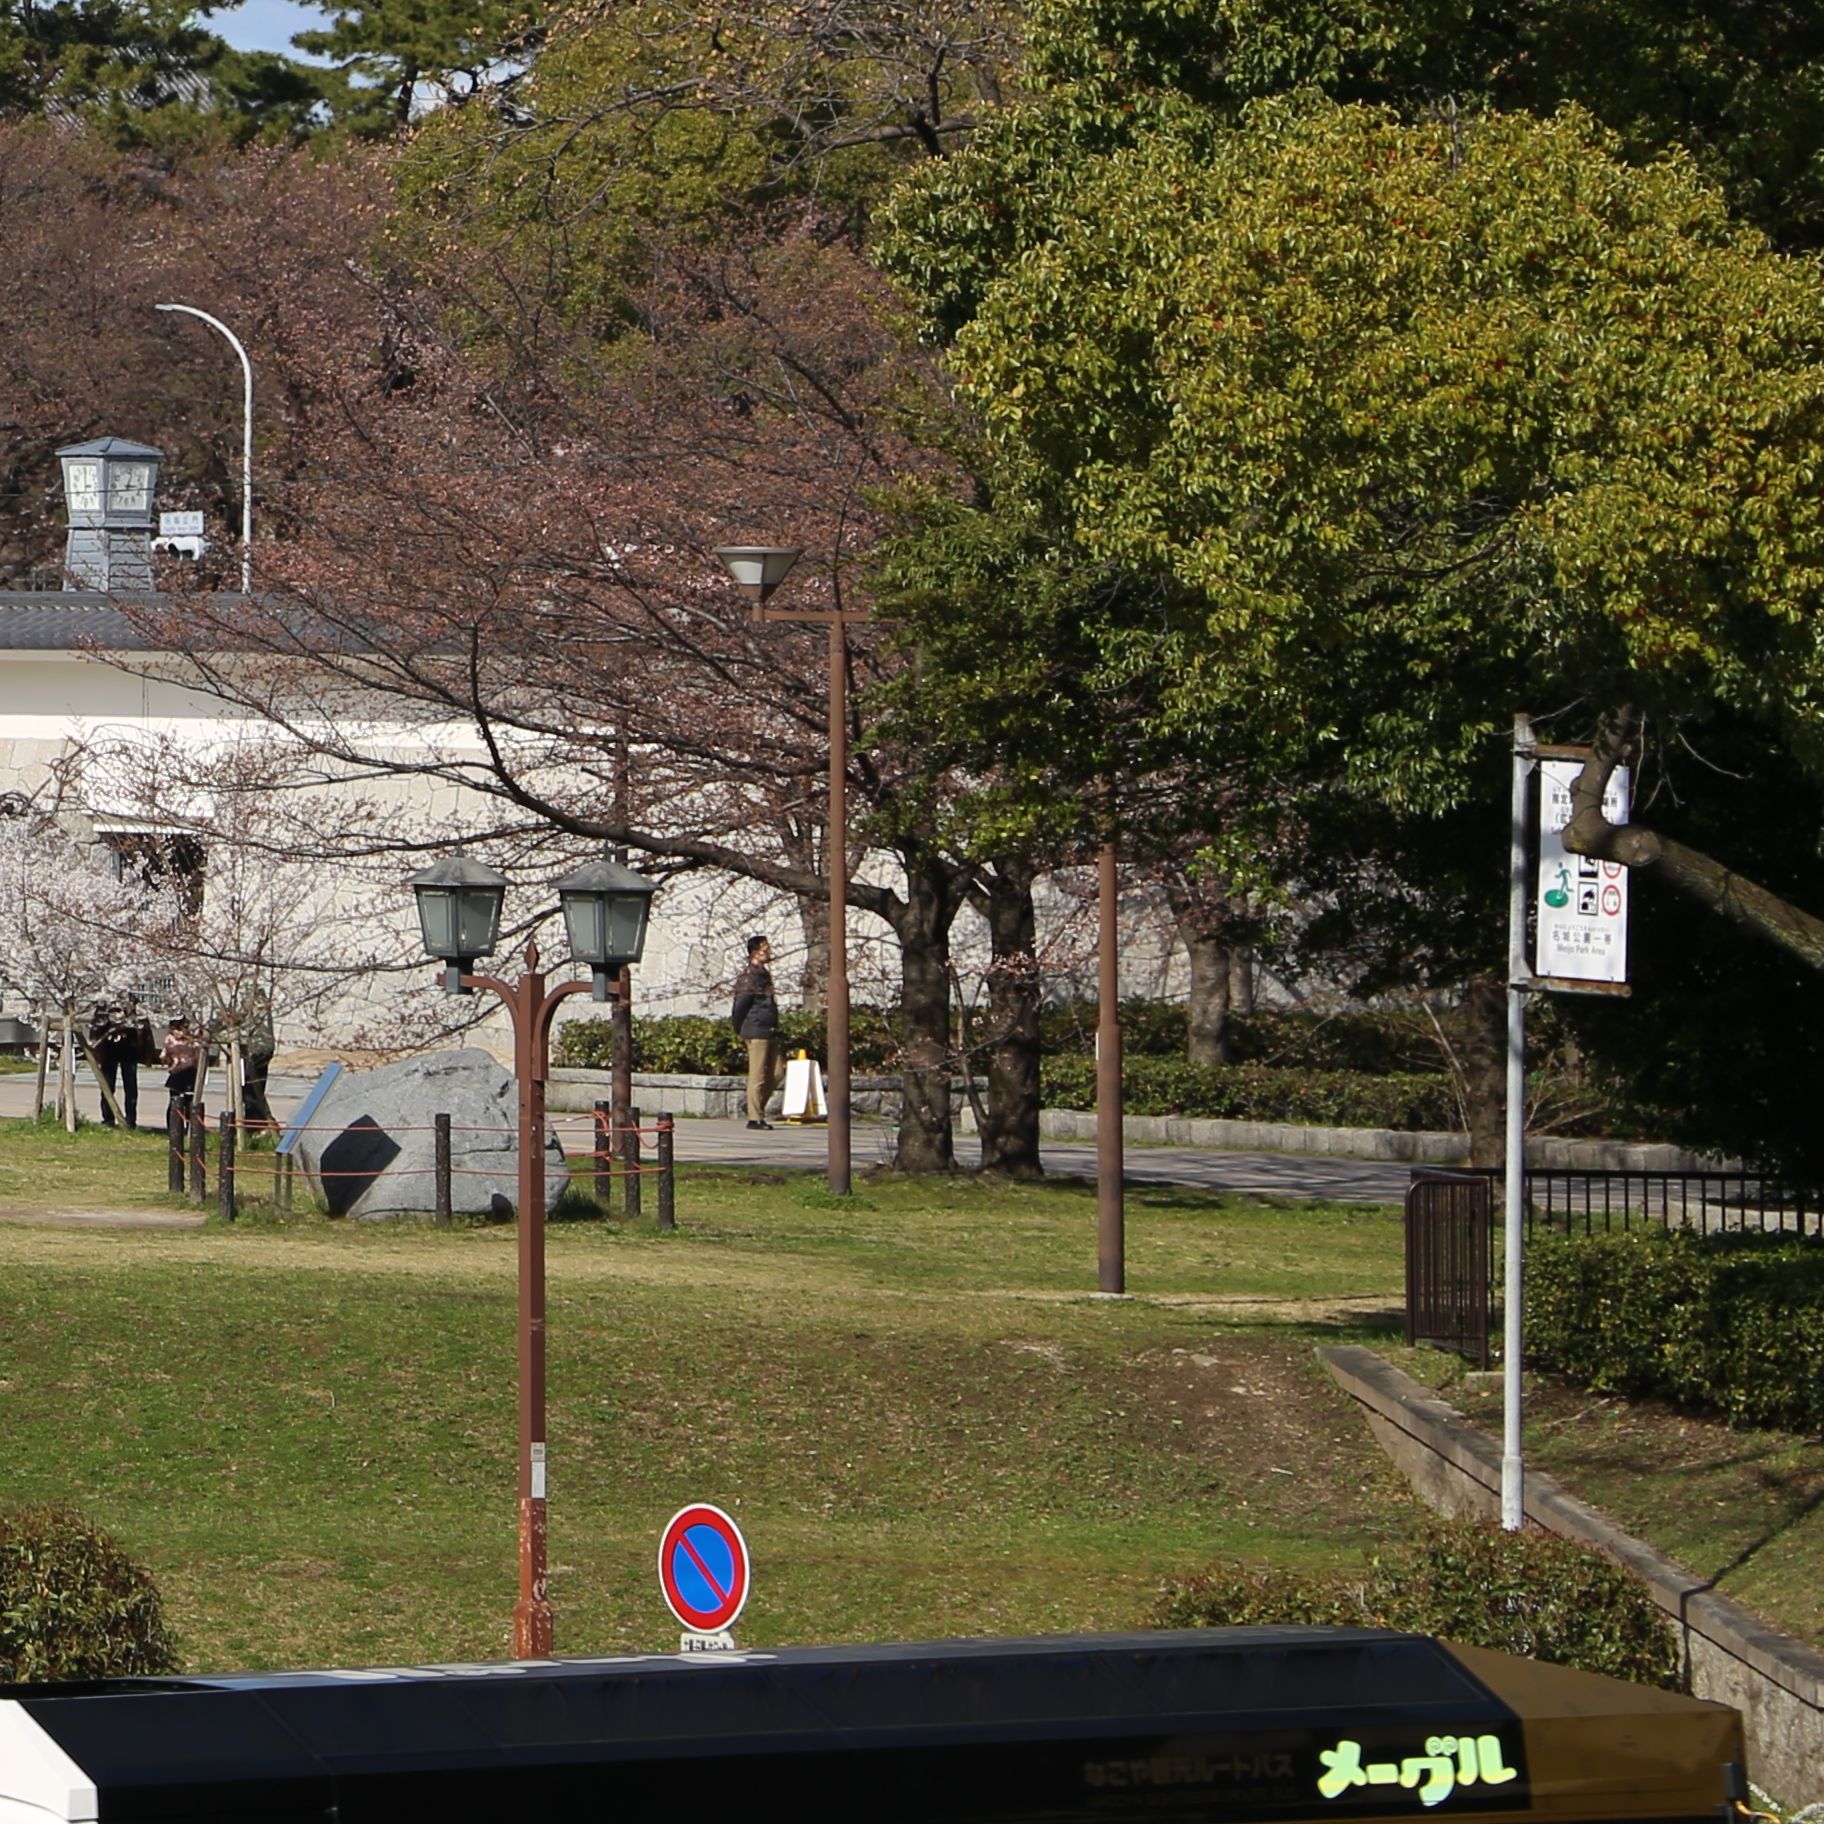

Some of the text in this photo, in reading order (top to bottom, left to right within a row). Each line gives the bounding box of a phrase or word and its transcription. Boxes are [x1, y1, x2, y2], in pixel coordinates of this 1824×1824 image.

[1576, 945, 1589, 954] Park
[1591, 947, 1606, 955] Area
[1317, 1734, 1517, 1806] メーグル
